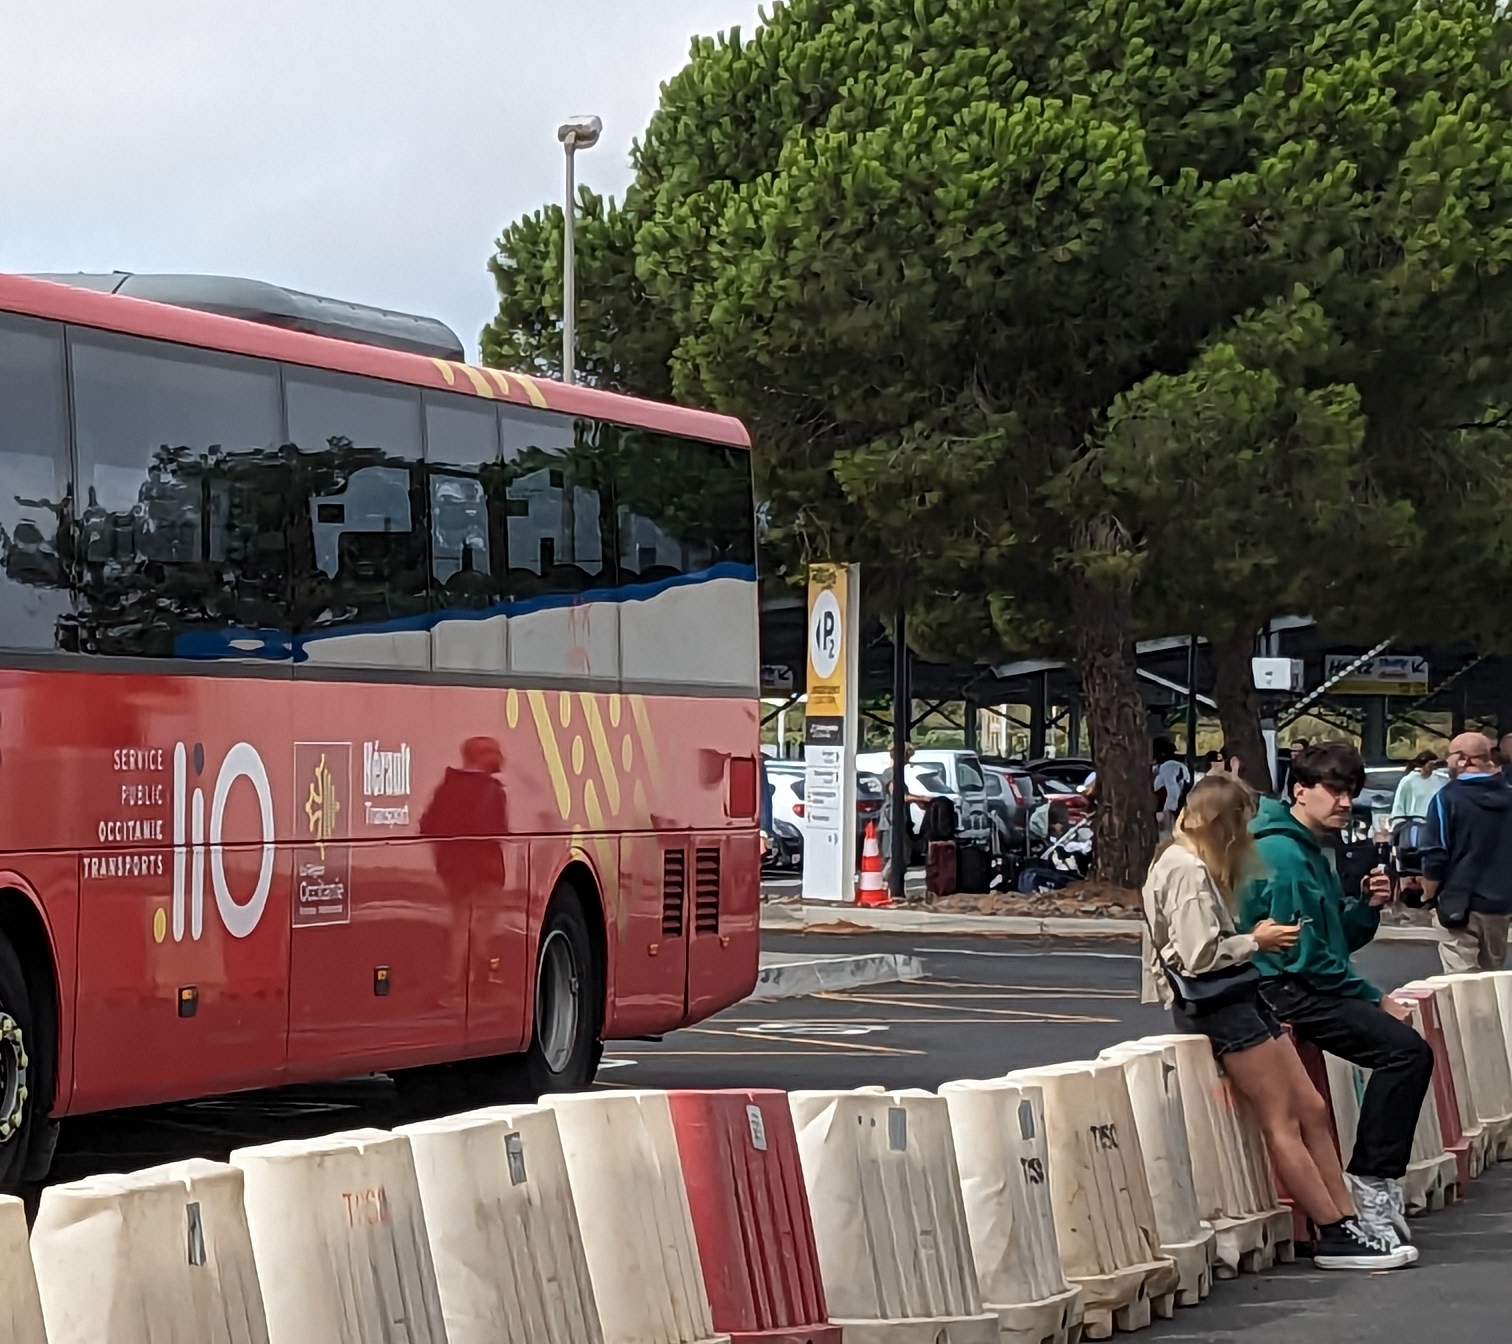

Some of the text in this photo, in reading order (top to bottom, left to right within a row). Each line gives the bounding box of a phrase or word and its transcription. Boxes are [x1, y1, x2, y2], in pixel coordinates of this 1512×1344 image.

[113, 749, 164, 771] SERVICE
[121, 784, 163, 805] PUBLIC
[98, 819, 163, 842] OCCITANIE
[83, 854, 163, 879] TRANSPORTS
